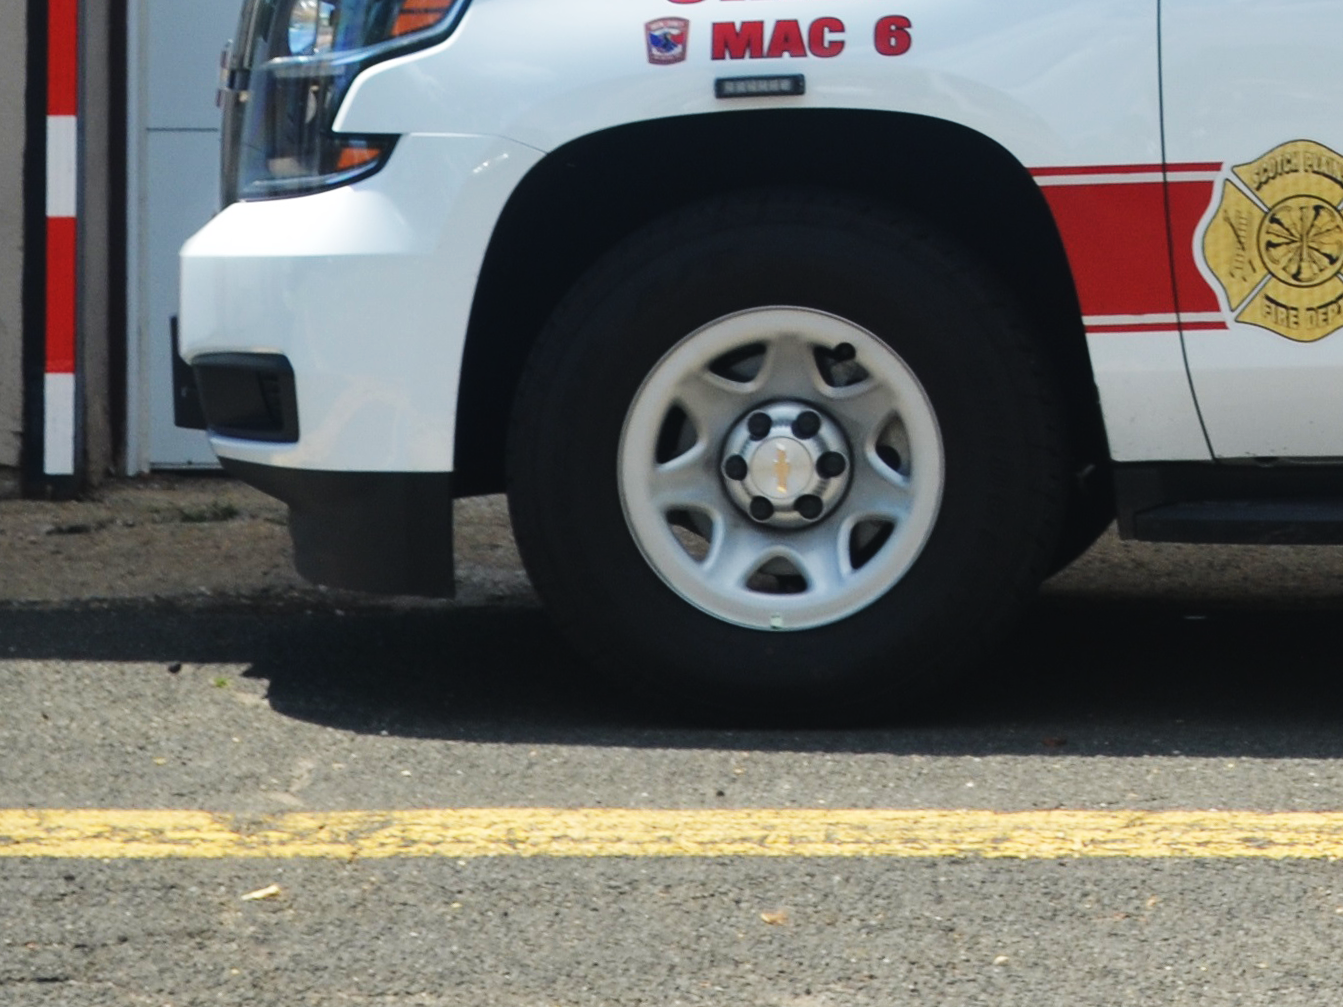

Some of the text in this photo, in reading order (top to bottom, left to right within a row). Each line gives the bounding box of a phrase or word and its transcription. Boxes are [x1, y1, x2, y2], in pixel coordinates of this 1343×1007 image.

[711, 14, 913, 60] MAC 6
[1252, 151, 1300, 191] SCOTCH
[1263, 295, 1300, 330] FIRE
